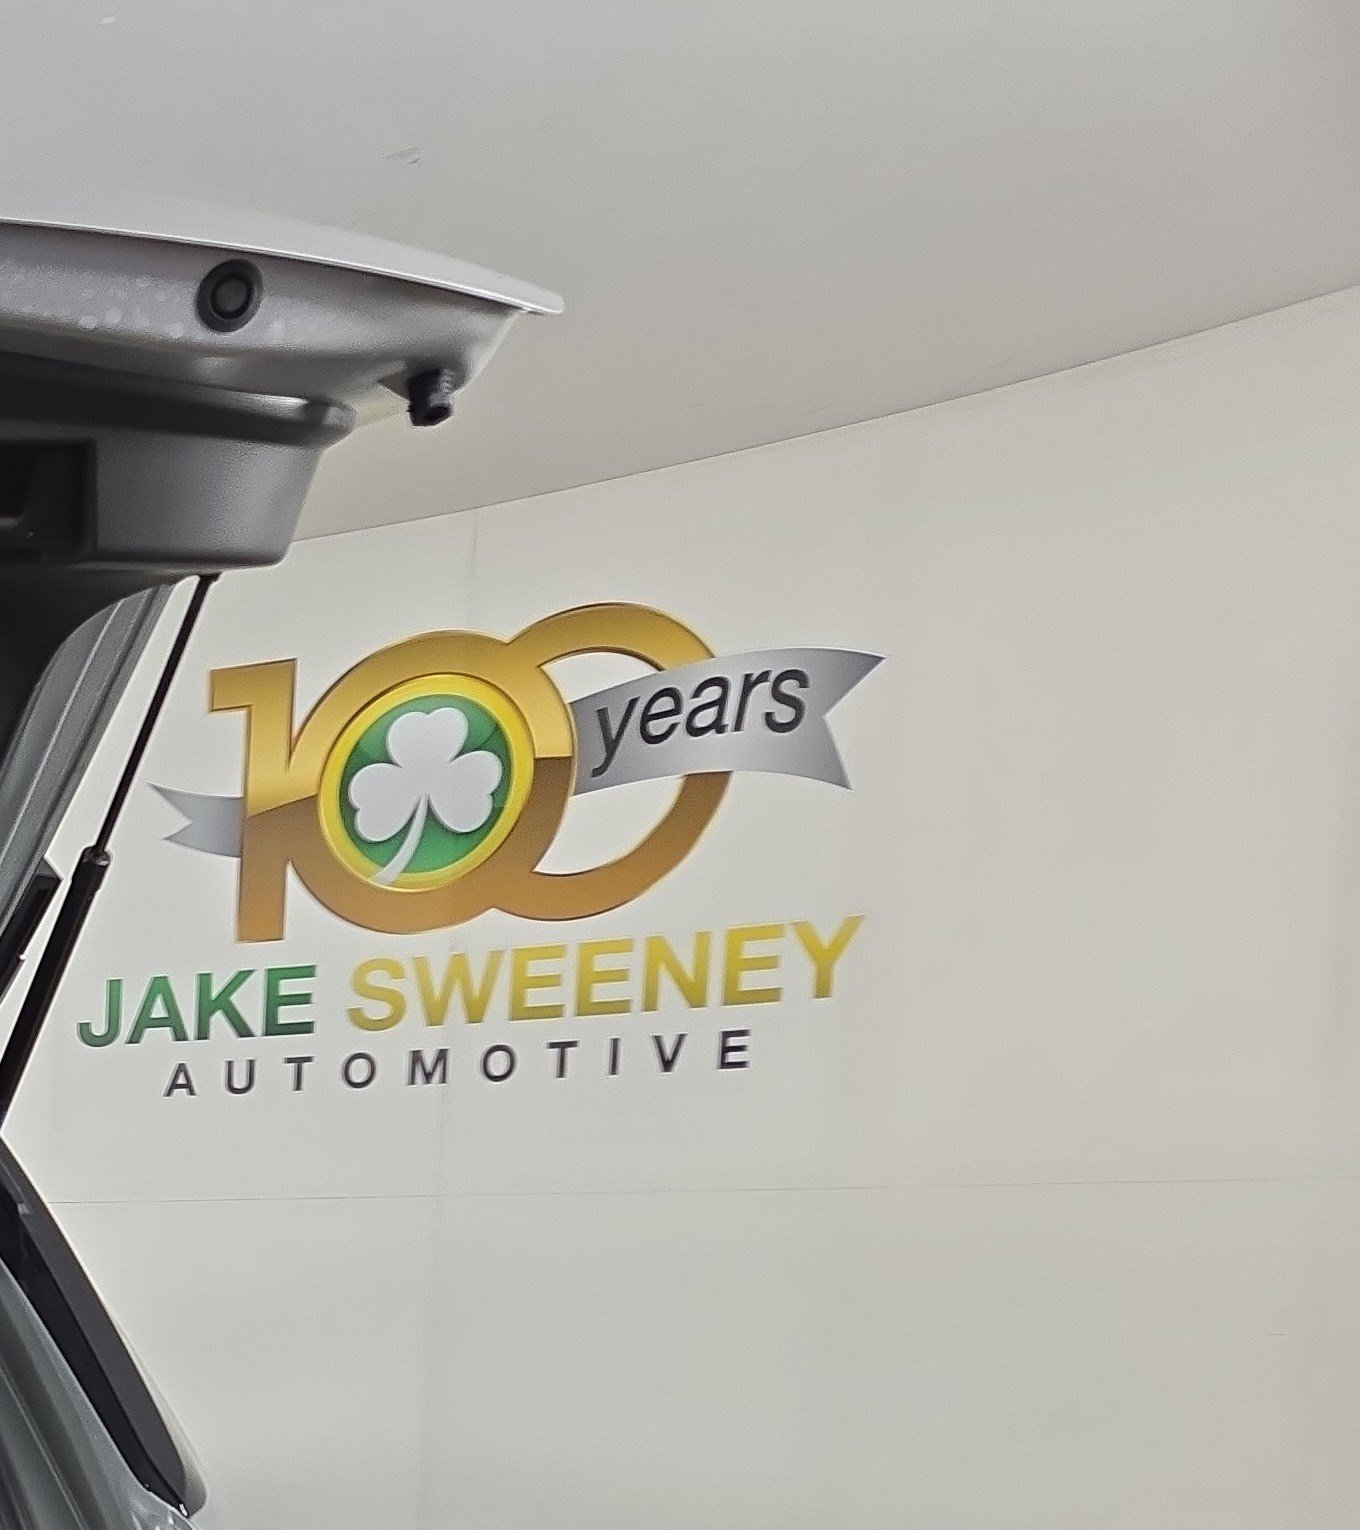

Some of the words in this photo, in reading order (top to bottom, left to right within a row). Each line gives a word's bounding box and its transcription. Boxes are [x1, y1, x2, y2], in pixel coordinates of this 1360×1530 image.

[592, 664, 811, 778] years
[76, 964, 316, 1048] JAKE
[346, 915, 865, 1031] SWEENEY
[163, 1028, 752, 1097] AUTOMOTIVE
